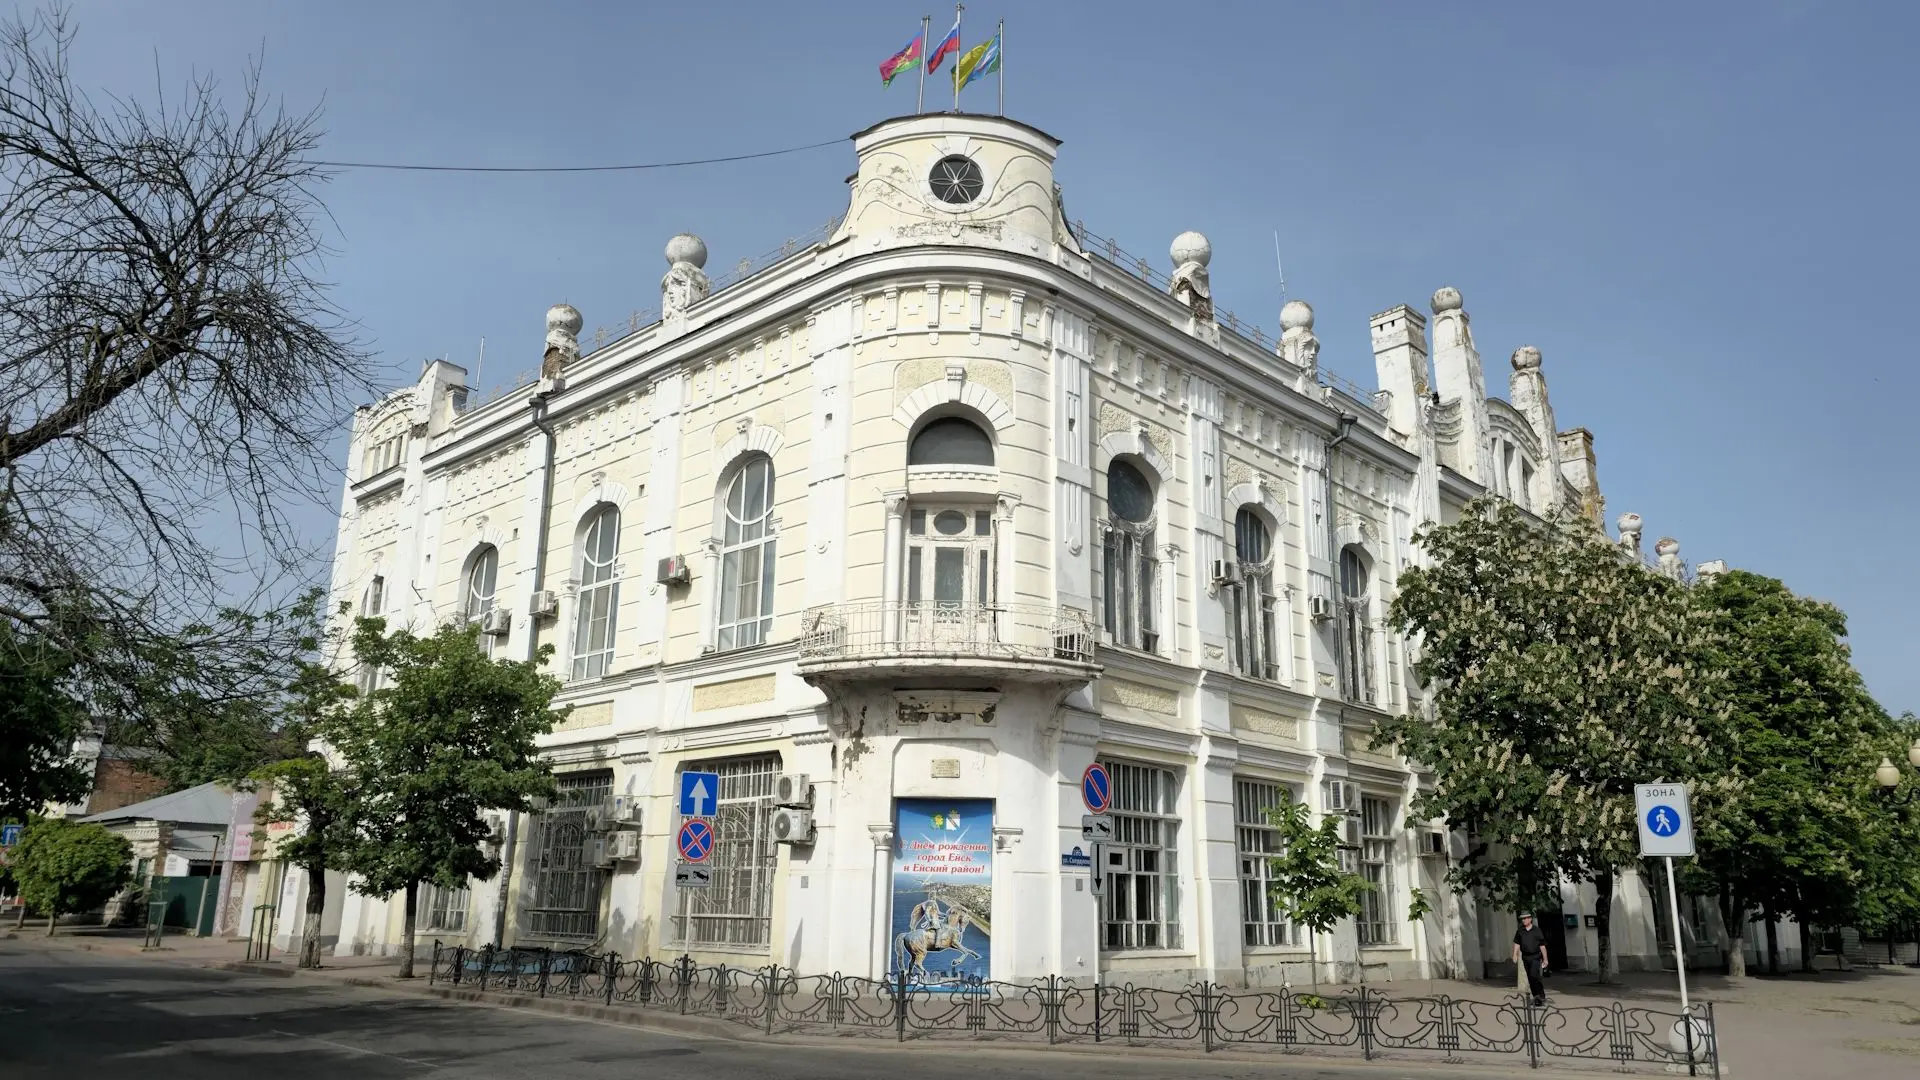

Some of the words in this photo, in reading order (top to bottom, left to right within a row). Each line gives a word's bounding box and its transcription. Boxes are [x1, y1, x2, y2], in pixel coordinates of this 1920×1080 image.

[1645, 788, 1676, 798] ЗОНА
[909, 840, 935, 850] Днём
[938, 842, 990, 851] рождения,
[917, 853, 945, 862] город
[948, 852, 972, 862] Ейск
[912, 863, 948, 872] Ейский
[951, 864, 985, 874] район!
